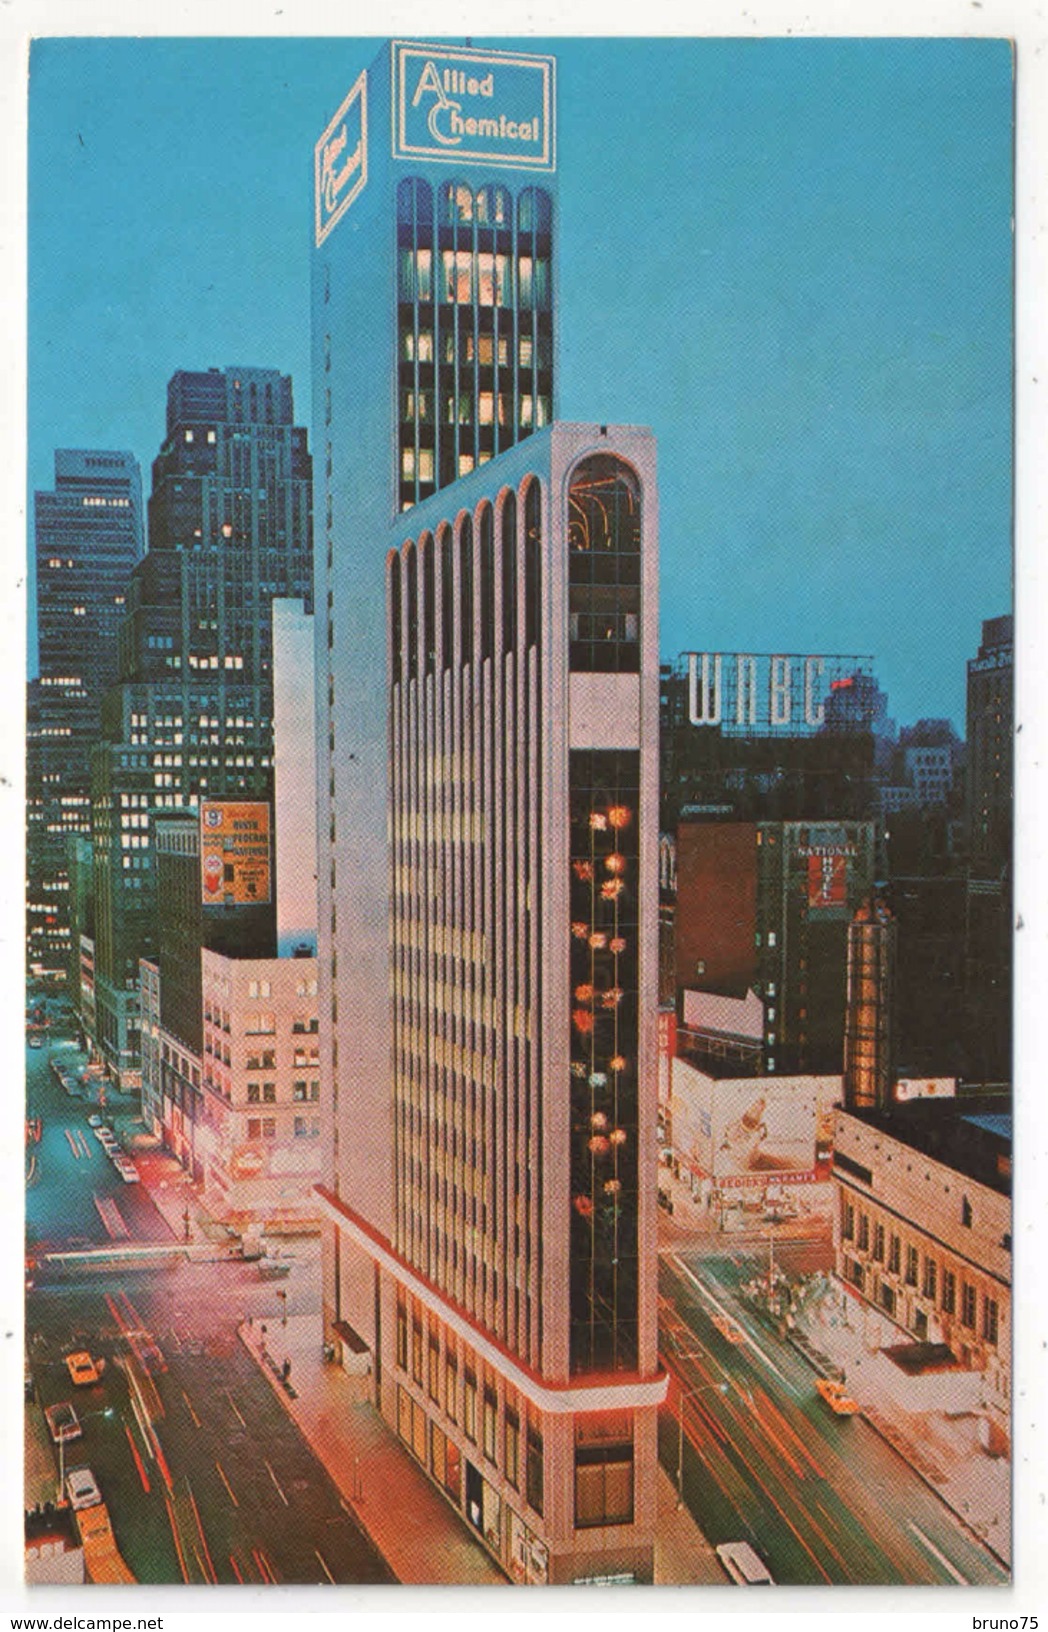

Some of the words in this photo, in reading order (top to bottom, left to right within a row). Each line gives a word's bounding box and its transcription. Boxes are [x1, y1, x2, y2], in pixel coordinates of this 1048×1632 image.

[412, 60, 494, 107] Allied
[427, 99, 540, 144] Chemical
[689, 652, 824, 727] WNBC
[797, 846, 858, 857] NATIONAL
[822, 856, 834, 900] HOTEL
